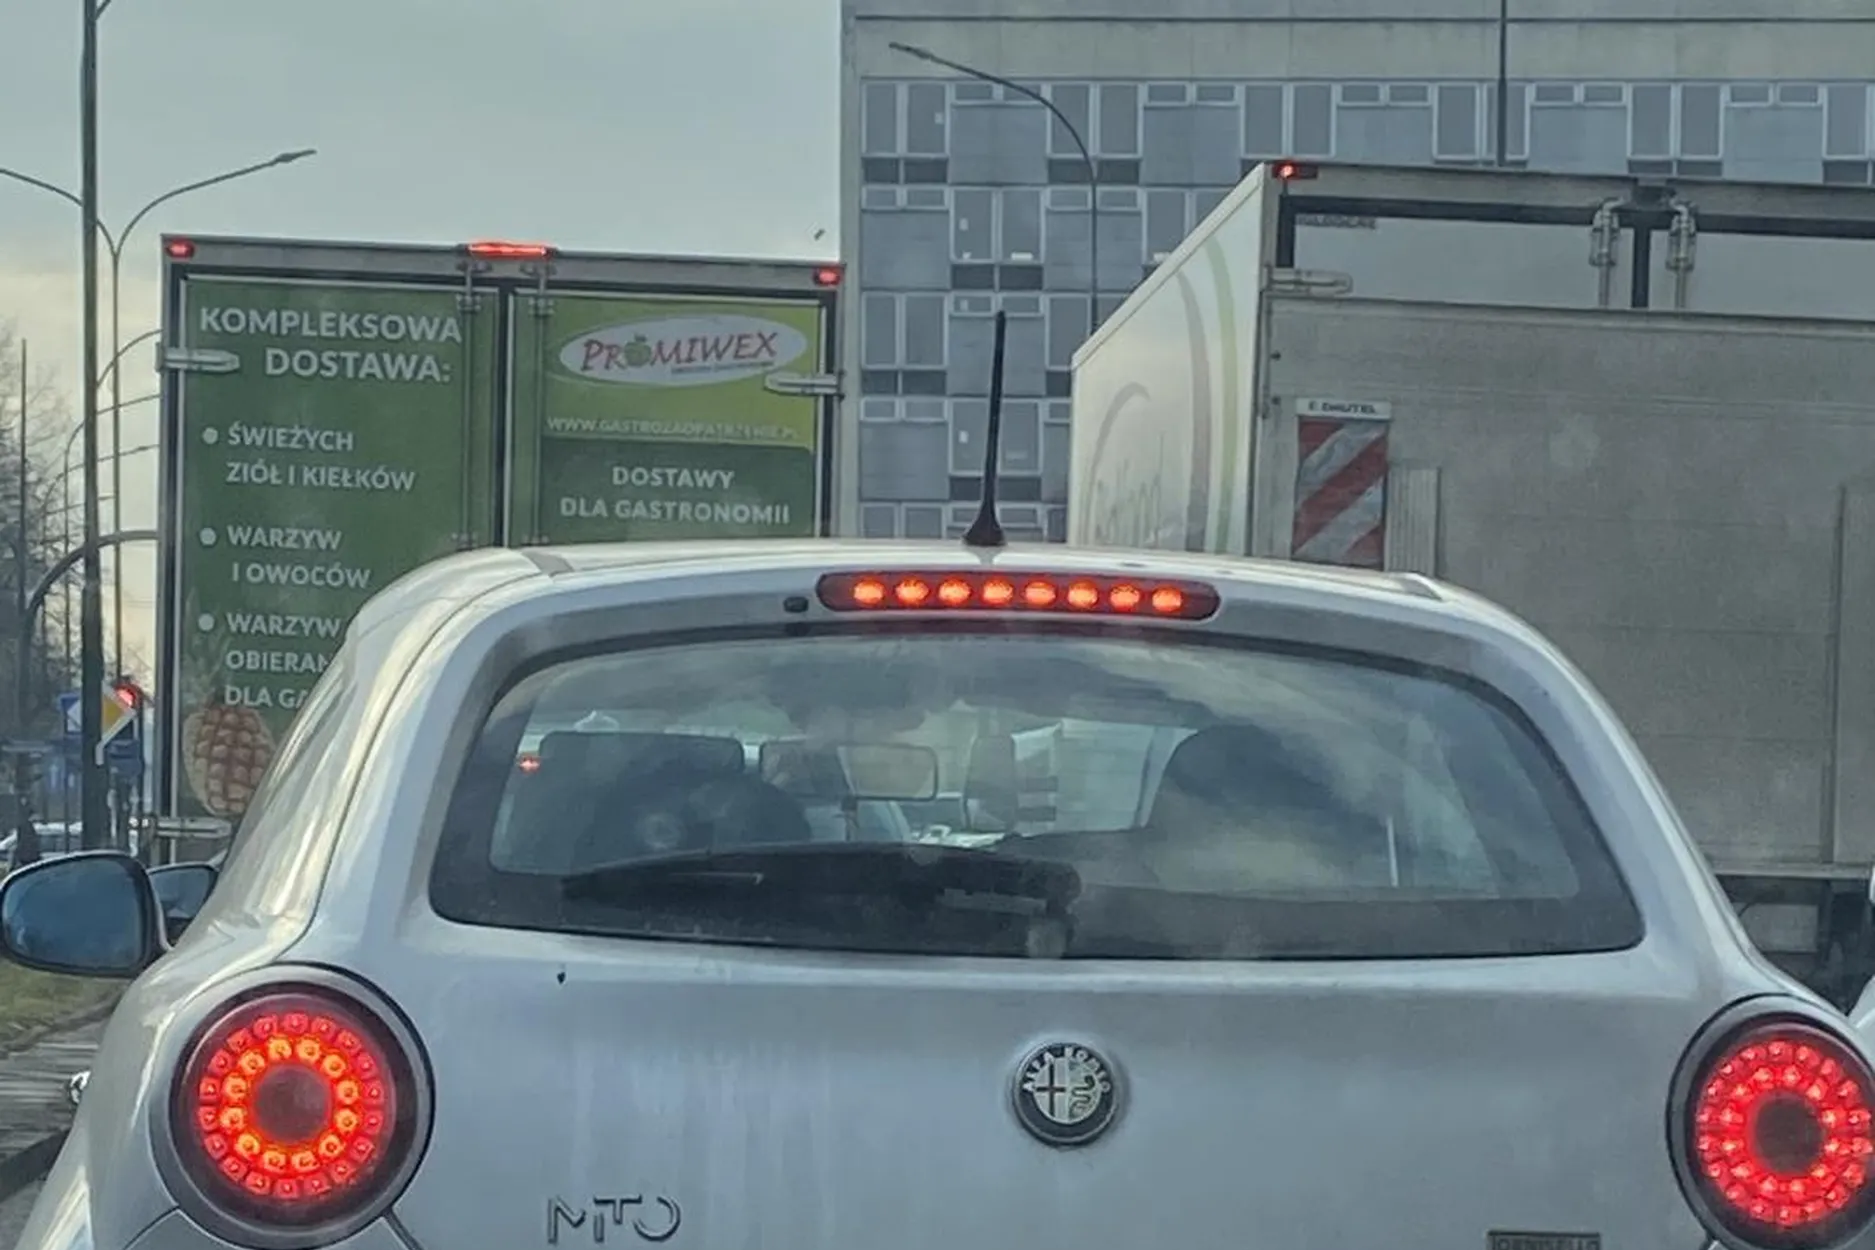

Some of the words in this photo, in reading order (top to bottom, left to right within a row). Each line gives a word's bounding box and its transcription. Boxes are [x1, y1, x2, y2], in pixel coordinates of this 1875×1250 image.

[200, 306, 463, 343] KOMPLEKSOWA
[264, 348, 451, 382] DOSTAWA:
[580, 332, 778, 371] PROMIWEX
[227, 421, 353, 451] ŚWIEŻYCH
[226, 460, 281, 484] ZIÓŁ
[288, 464, 295, 484] I
[302, 465, 415, 490] KIEŁKÓW
[612, 466, 734, 489] DOSTAWY
[560, 498, 608, 518] DLA
[614, 500, 790, 524] GASTRONOMII
[227, 525, 342, 550] WARZYW
[232, 562, 239, 582] I
[246, 561, 371, 588] OWOCÓW
[226, 612, 341, 637] WARZYW
[225, 685, 271, 705] DLA
